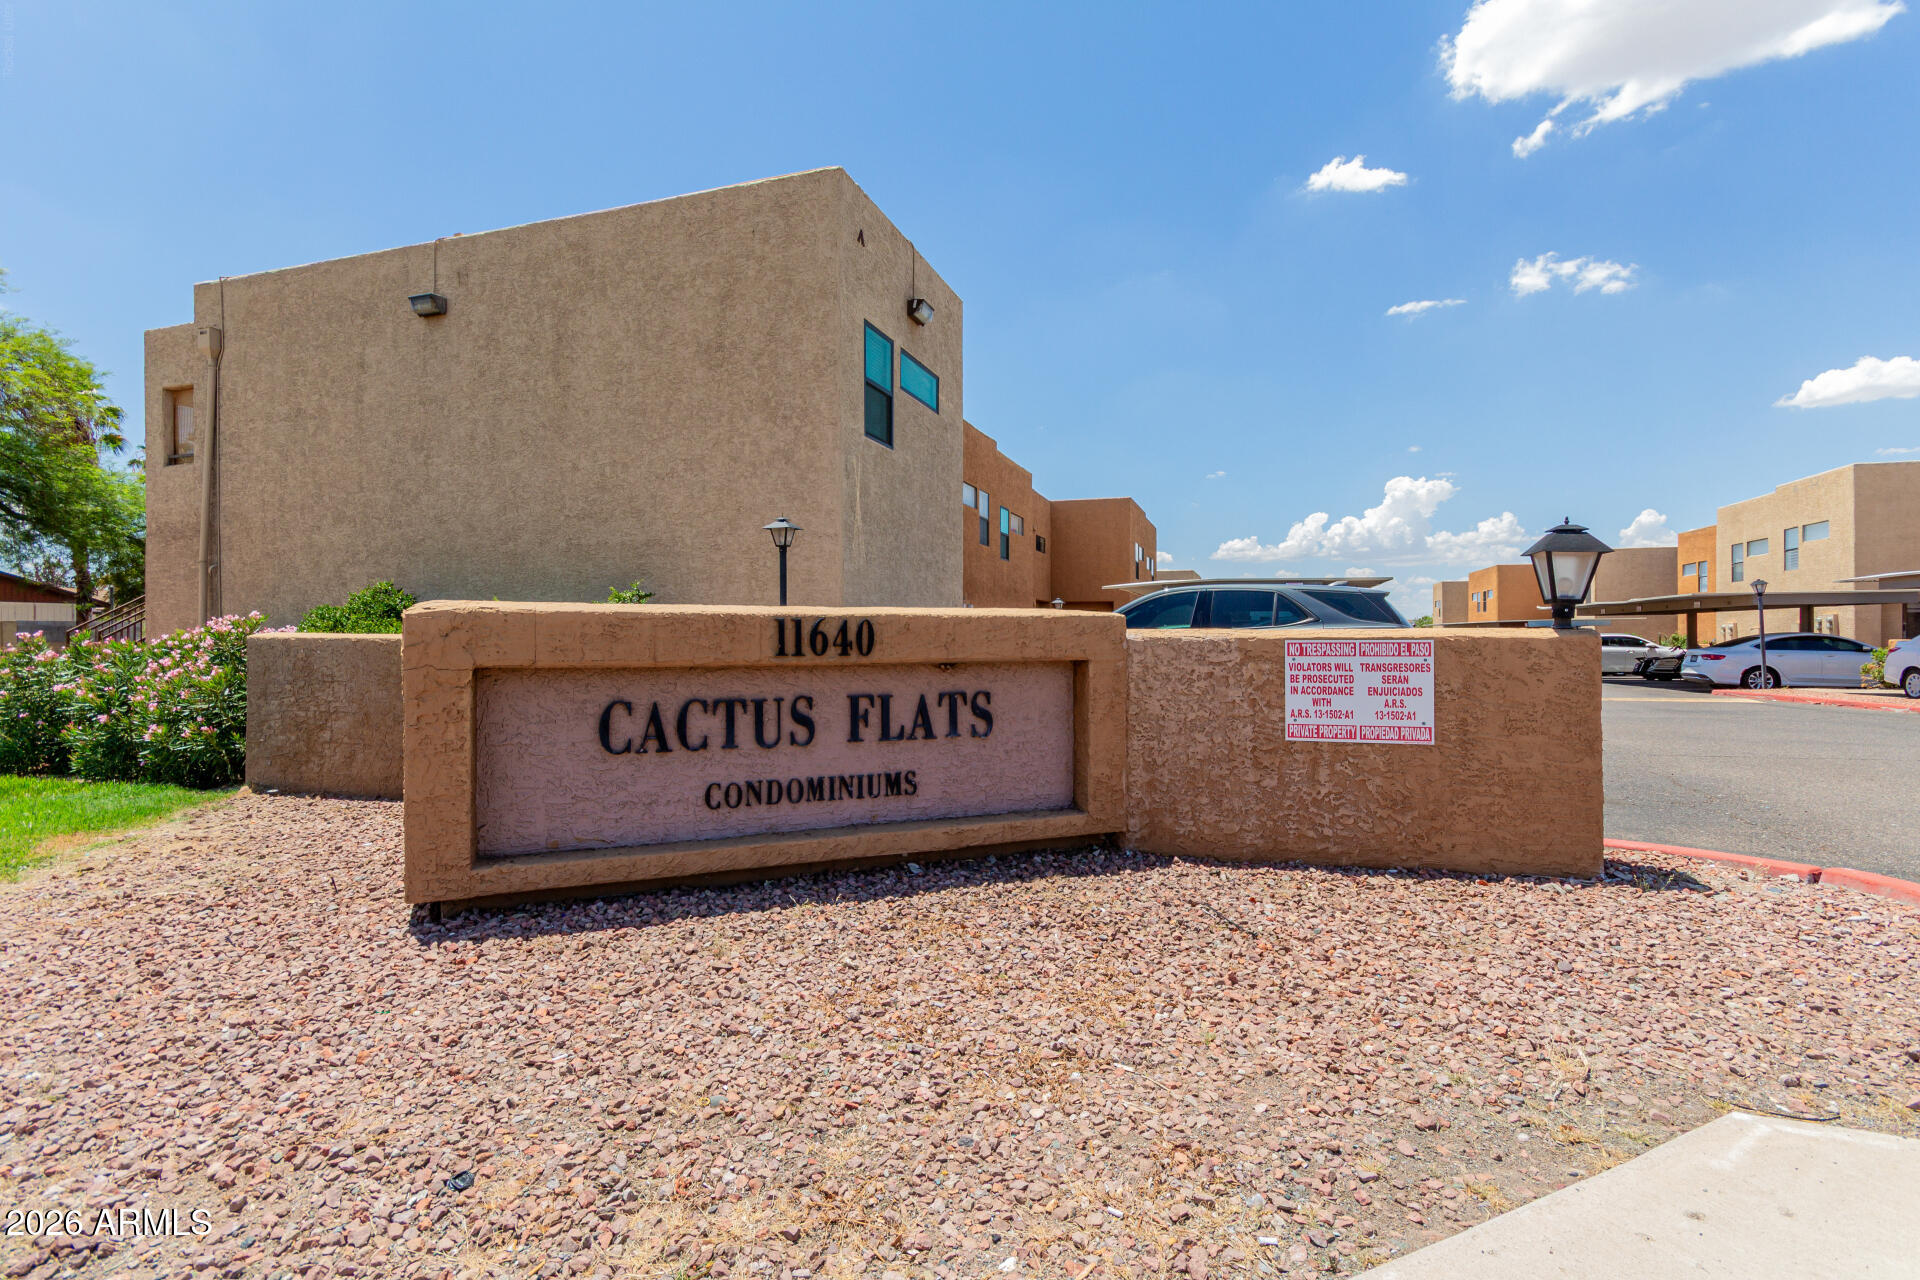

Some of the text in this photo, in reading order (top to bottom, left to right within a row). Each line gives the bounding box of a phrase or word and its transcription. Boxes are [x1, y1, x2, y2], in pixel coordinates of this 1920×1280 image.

[774, 617, 875, 657] 11640
[1289, 643, 1355, 656] NO TRESPASSING
[1361, 643, 1430, 656] PROHIBIDO EL PASO
[1288, 662, 1353, 672] VIOLATORS WILL
[1360, 663, 1431, 673] TRANSGRESORES
[1290, 674, 1354, 684] BE PROSECUTED
[1290, 686, 1354, 696] IN ACCORDANCE
[1367, 687, 1423, 697] ENJUICIADOS
[1311, 697, 1332, 707] WITH
[1384, 699, 1407, 709] A.R.S.
[1290, 709, 1354, 720] A.R.S. 13-1502-A1
[1375, 710, 1416, 721] 13-1502-A1
[599, 690, 994, 755] CACTUS FLATS
[1289, 725, 1356, 739] PRIVATE PROPERTY
[1361, 726, 1430, 741] PROPIEDAD PRIVADA
[704, 770, 918, 810] CONDOMINIUMS
